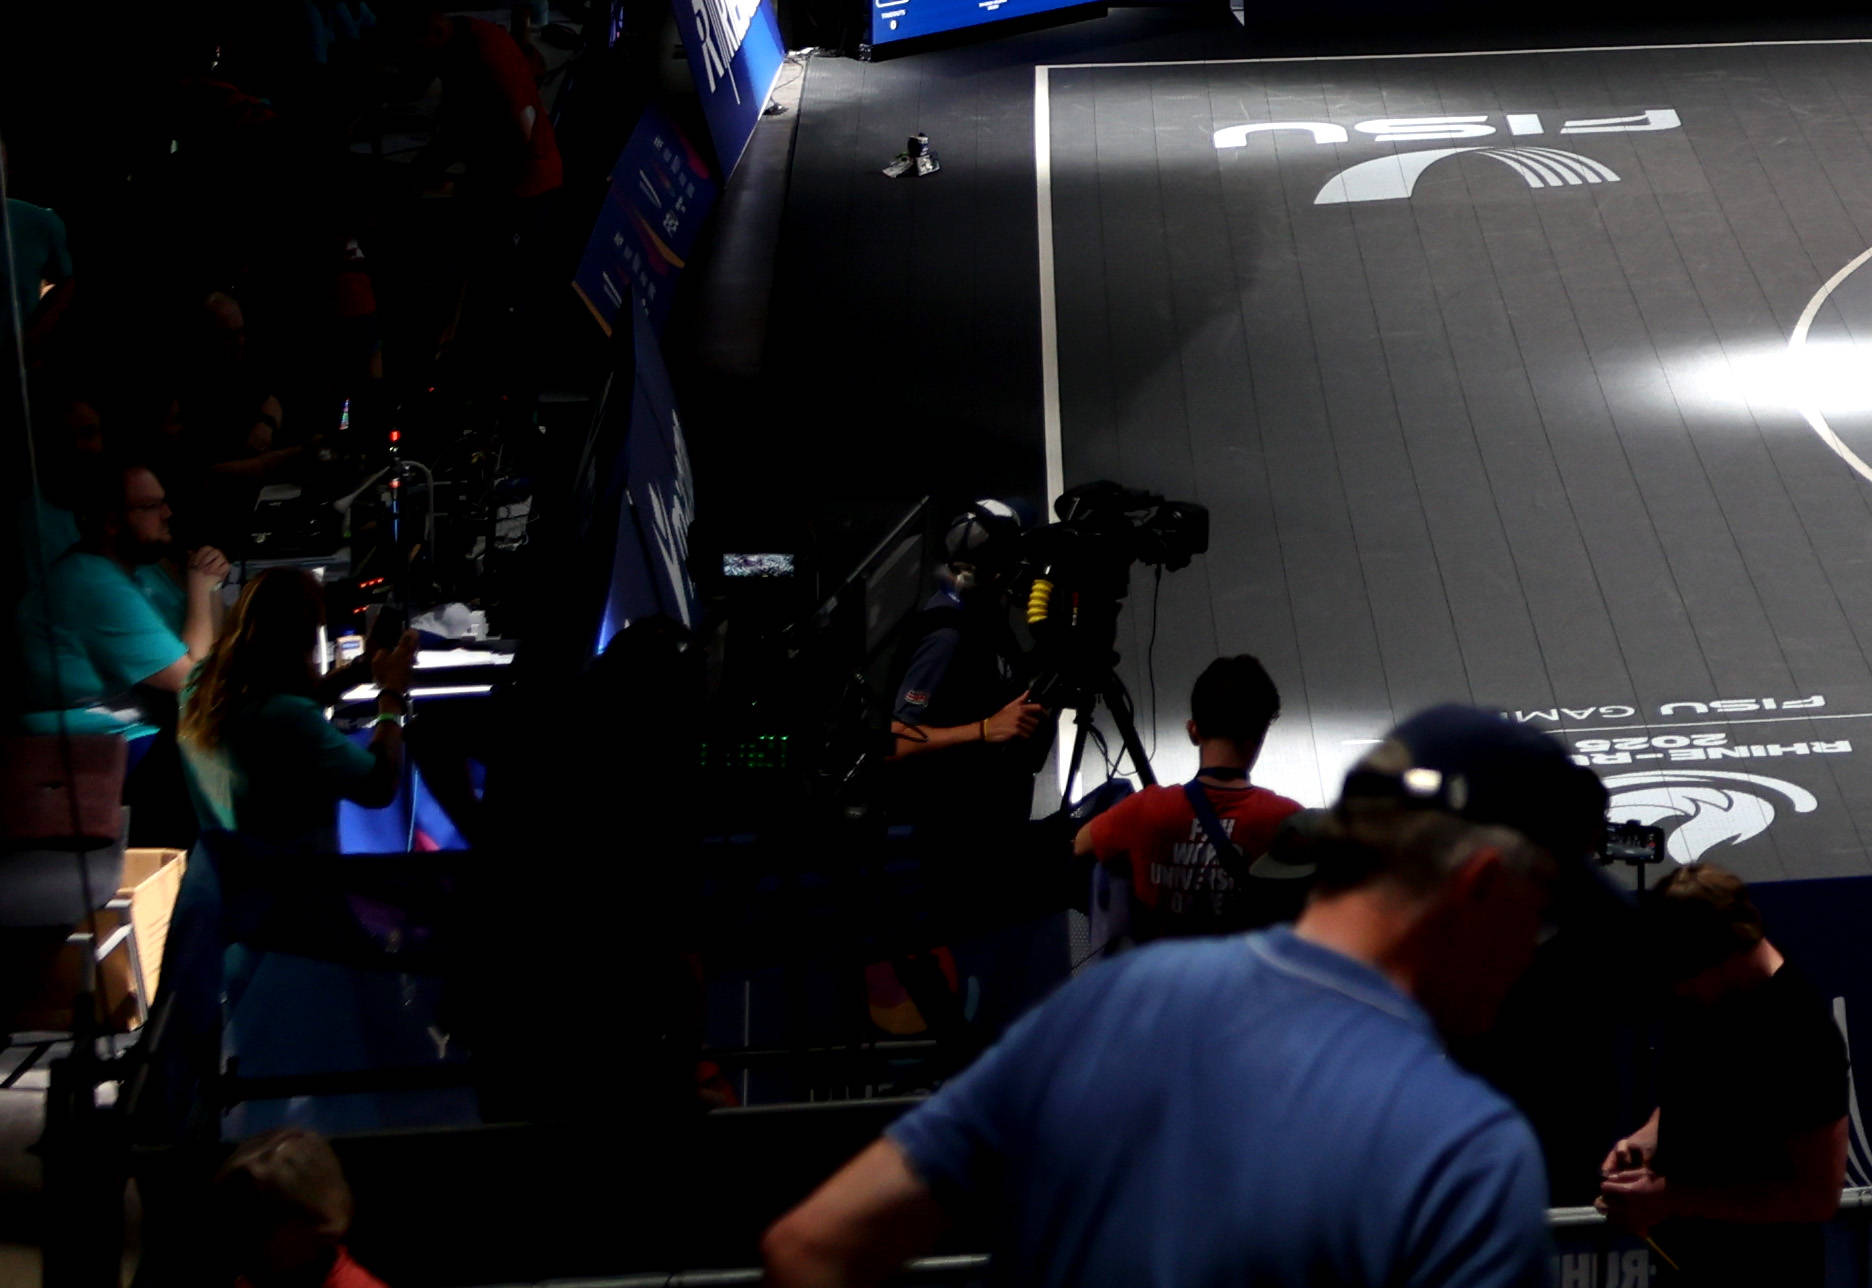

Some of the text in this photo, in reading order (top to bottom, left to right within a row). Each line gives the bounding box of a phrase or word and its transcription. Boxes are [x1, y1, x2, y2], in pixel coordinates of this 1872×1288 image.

[1213, 108, 1682, 149] FISU
[1660, 694, 1827, 716] FISU
[1575, 732, 1728, 752] 2025
